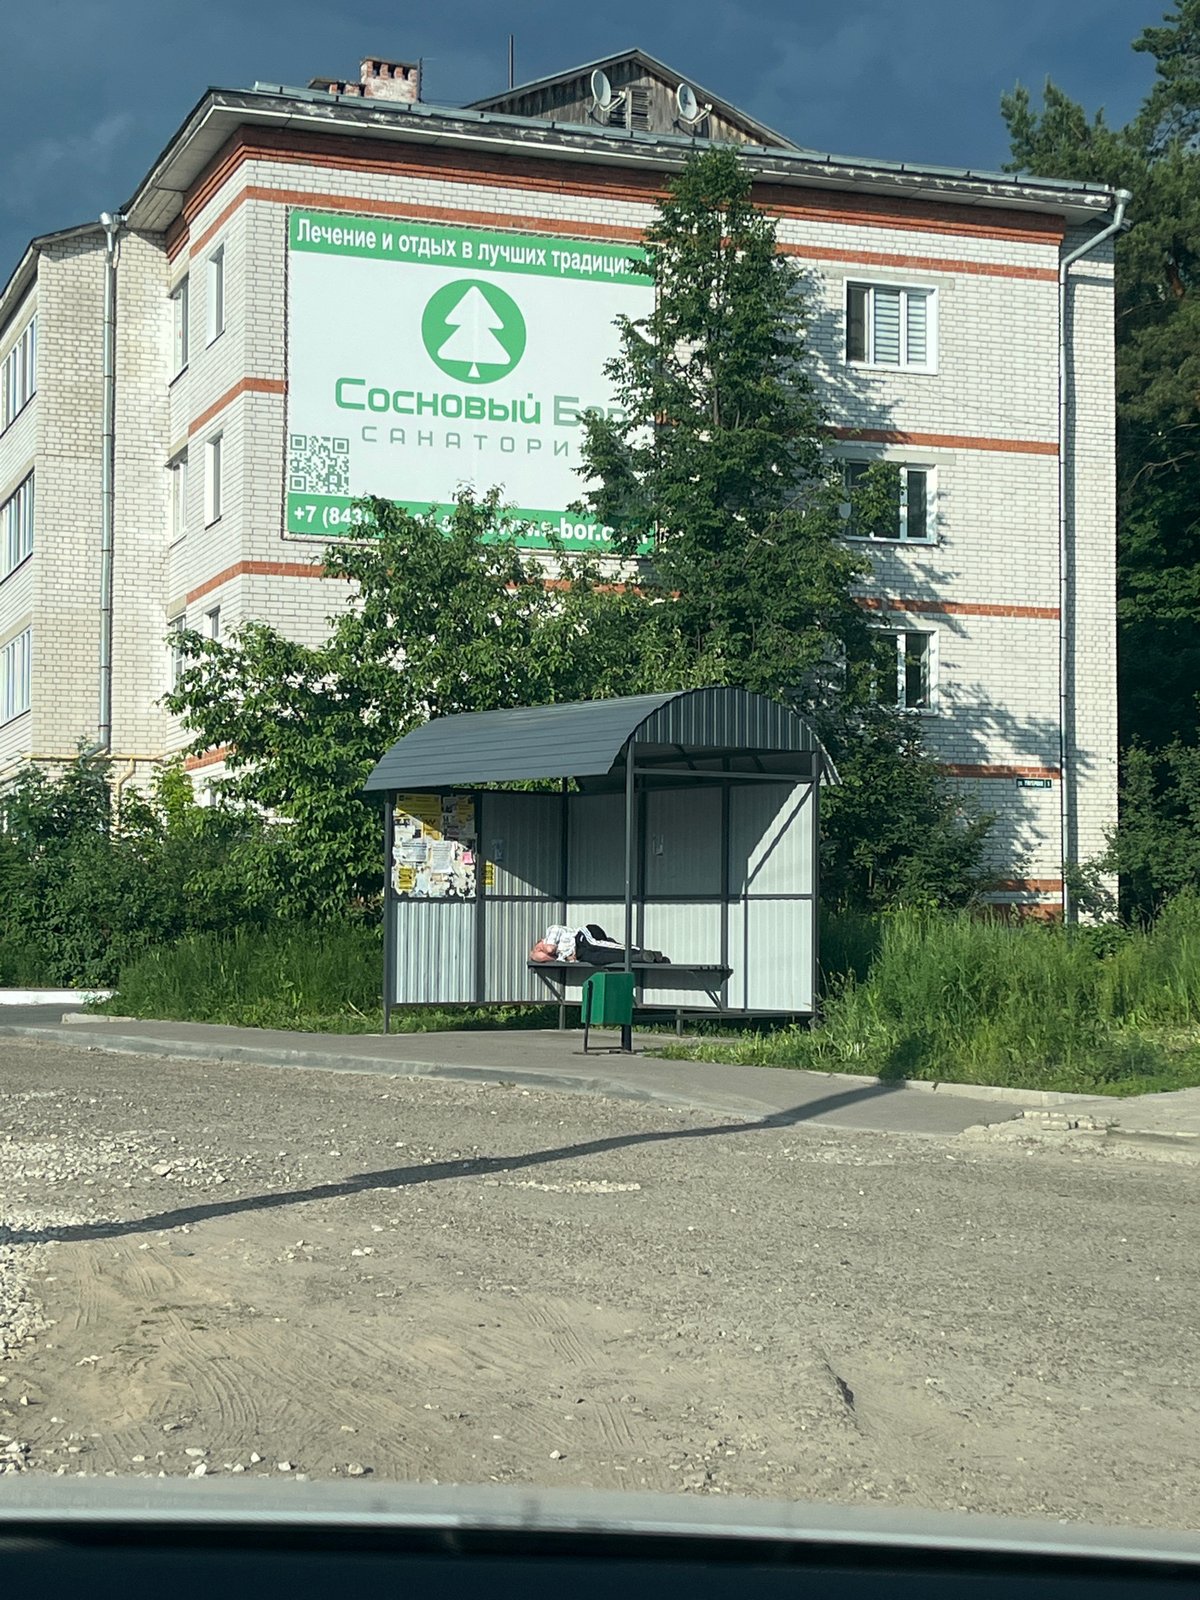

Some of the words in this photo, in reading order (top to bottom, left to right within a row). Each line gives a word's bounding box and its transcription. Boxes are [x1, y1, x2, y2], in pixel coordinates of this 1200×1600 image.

[296, 218, 377, 250] Лечение
[381, 232, 393, 251] и
[398, 234, 457, 259] отдых
[462, 241, 473, 259] в
[477, 243, 546, 268] лучших
[361, 426, 578, 458] САНАТОРИ
[294, 505, 317, 524] +7
